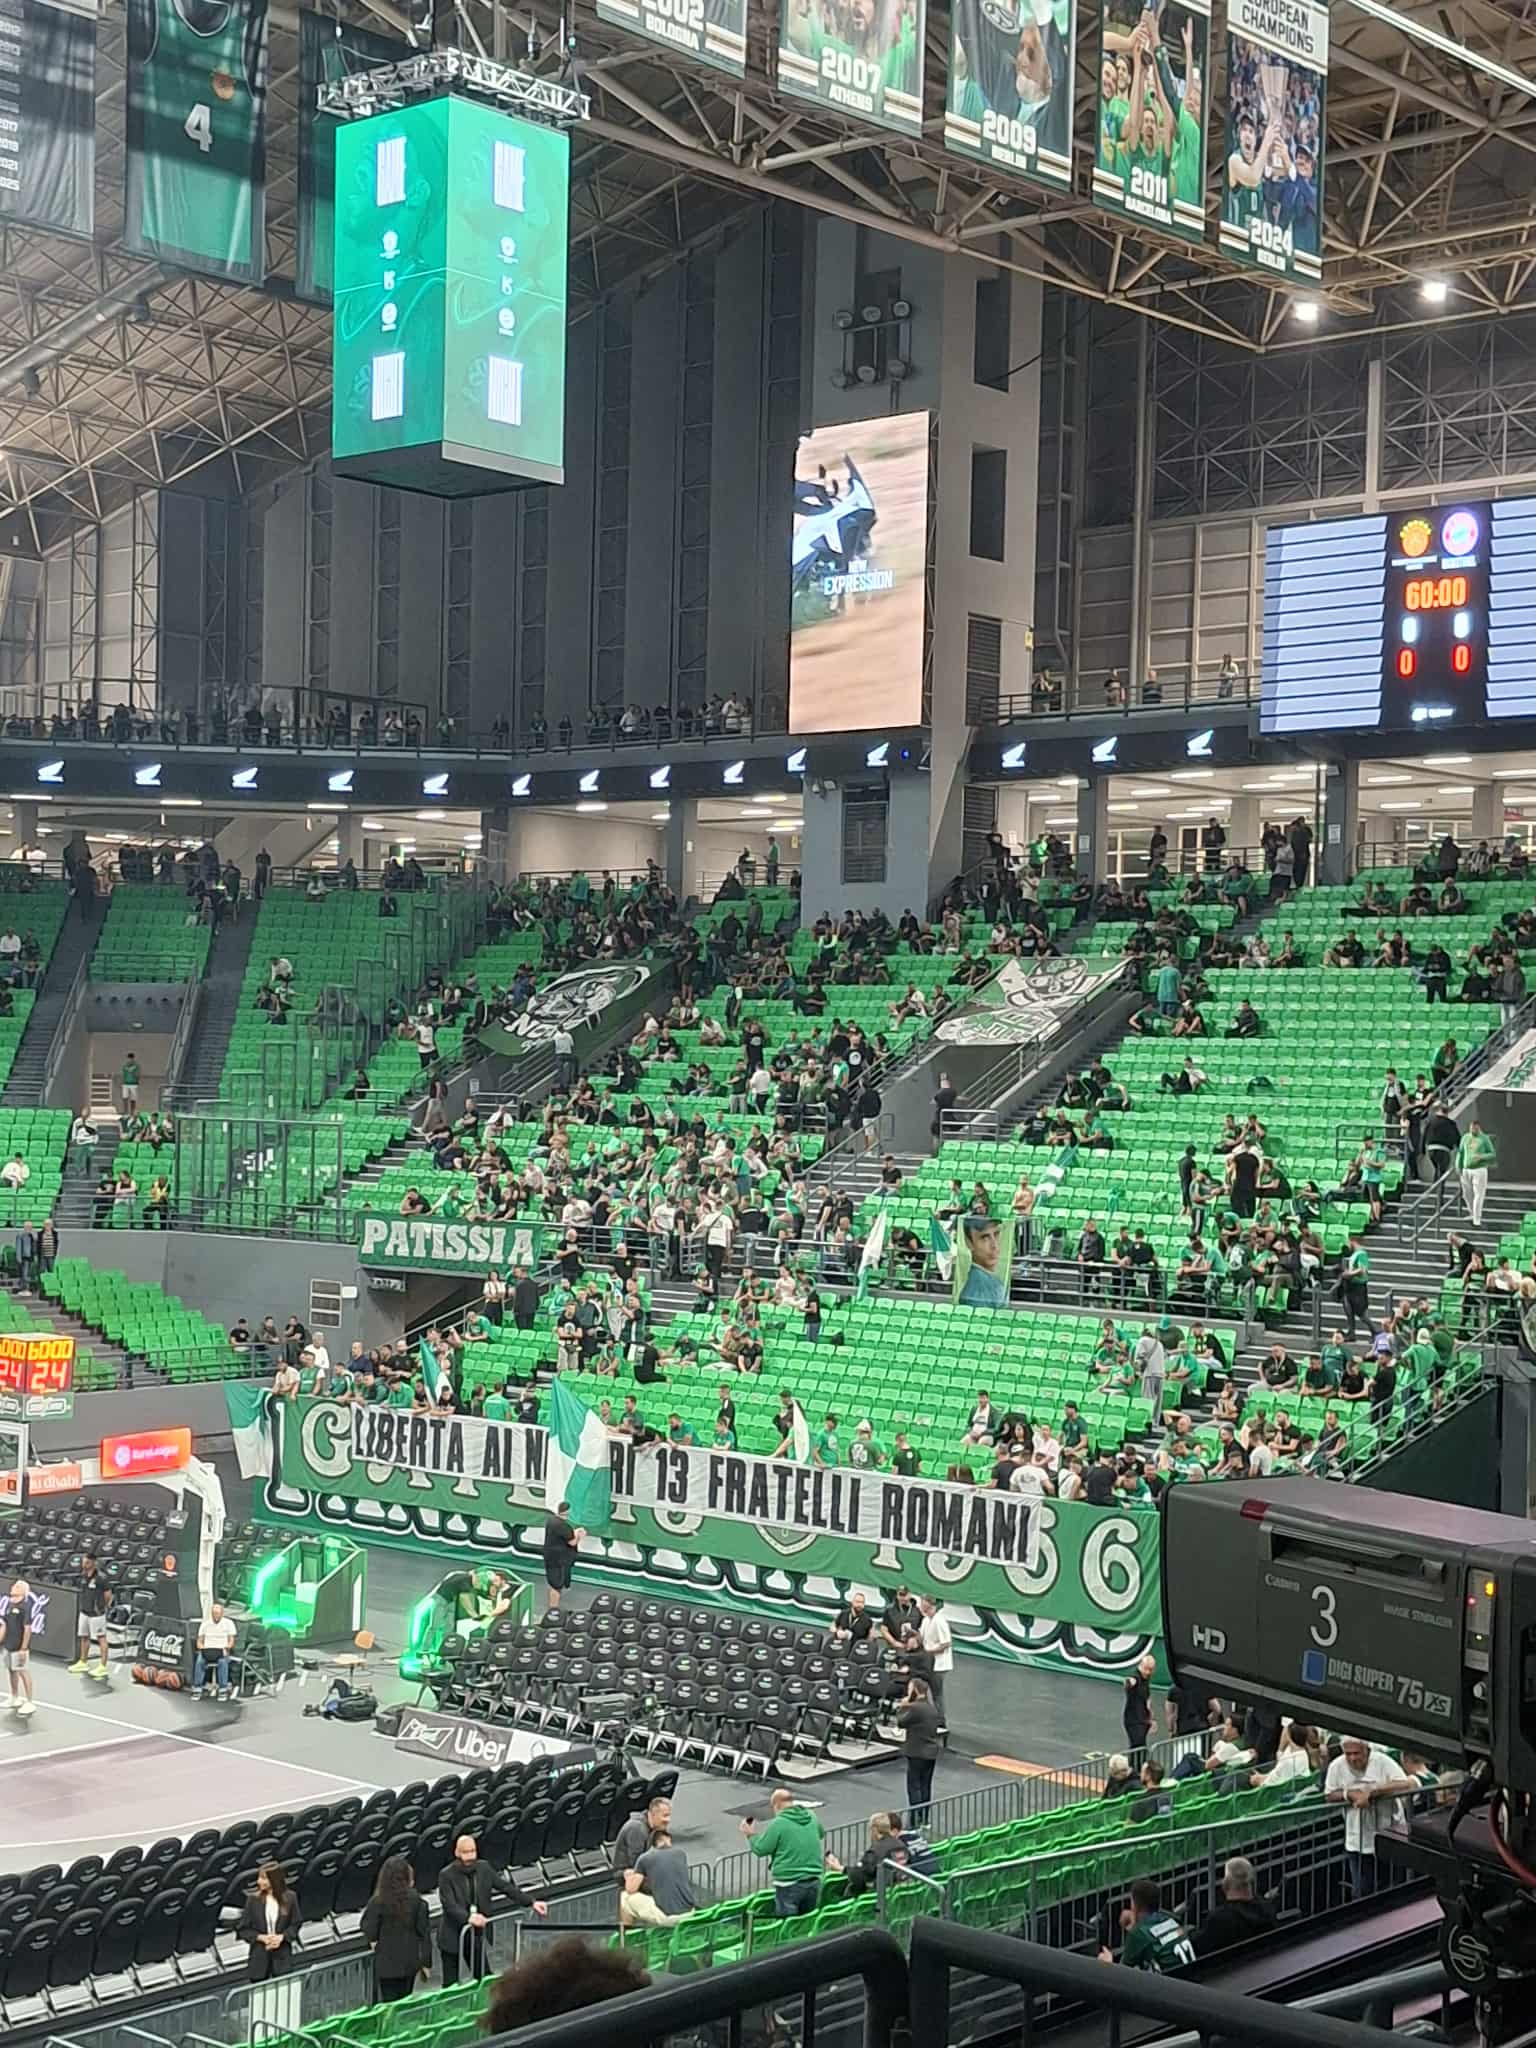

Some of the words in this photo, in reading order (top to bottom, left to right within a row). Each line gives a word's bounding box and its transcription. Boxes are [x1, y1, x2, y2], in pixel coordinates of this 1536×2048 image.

[1242, 4, 1314, 53] CHAMPIONS
[1247, 0, 1309, 30] ROPEAN
[821, 46, 881, 94] 2007
[184, 103, 213, 152] 4
[983, 109, 1036, 155] 2009
[1131, 166, 1167, 205] 2011
[1250, 216, 1293, 257] 2024
[823, 570, 894, 596] EXPRESSION
[1406, 577, 1466, 610] 60:00
[1399, 649, 1413, 675] 0
[1455, 645, 1468, 671] 0
[361, 1219, 535, 1266] PATISSIA
[31, 1361, 68, 1389] 24
[353, 1403, 465, 1474] LIBERTA
[481, 1425, 512, 1479] AI
[655, 1448, 690, 1504] 13
[708, 1454, 862, 1534] FRATELLI
[880, 1482, 1032, 1563] ROMANI
[1309, 1585, 1339, 1647] 3
[1192, 1624, 1228, 1654] HD
[1328, 1657, 1352, 1676] DIGI
[1354, 1665, 1394, 1692] SUPER
[1396, 1676, 1424, 1709] 75
[453, 1727, 506, 1763] Uber
